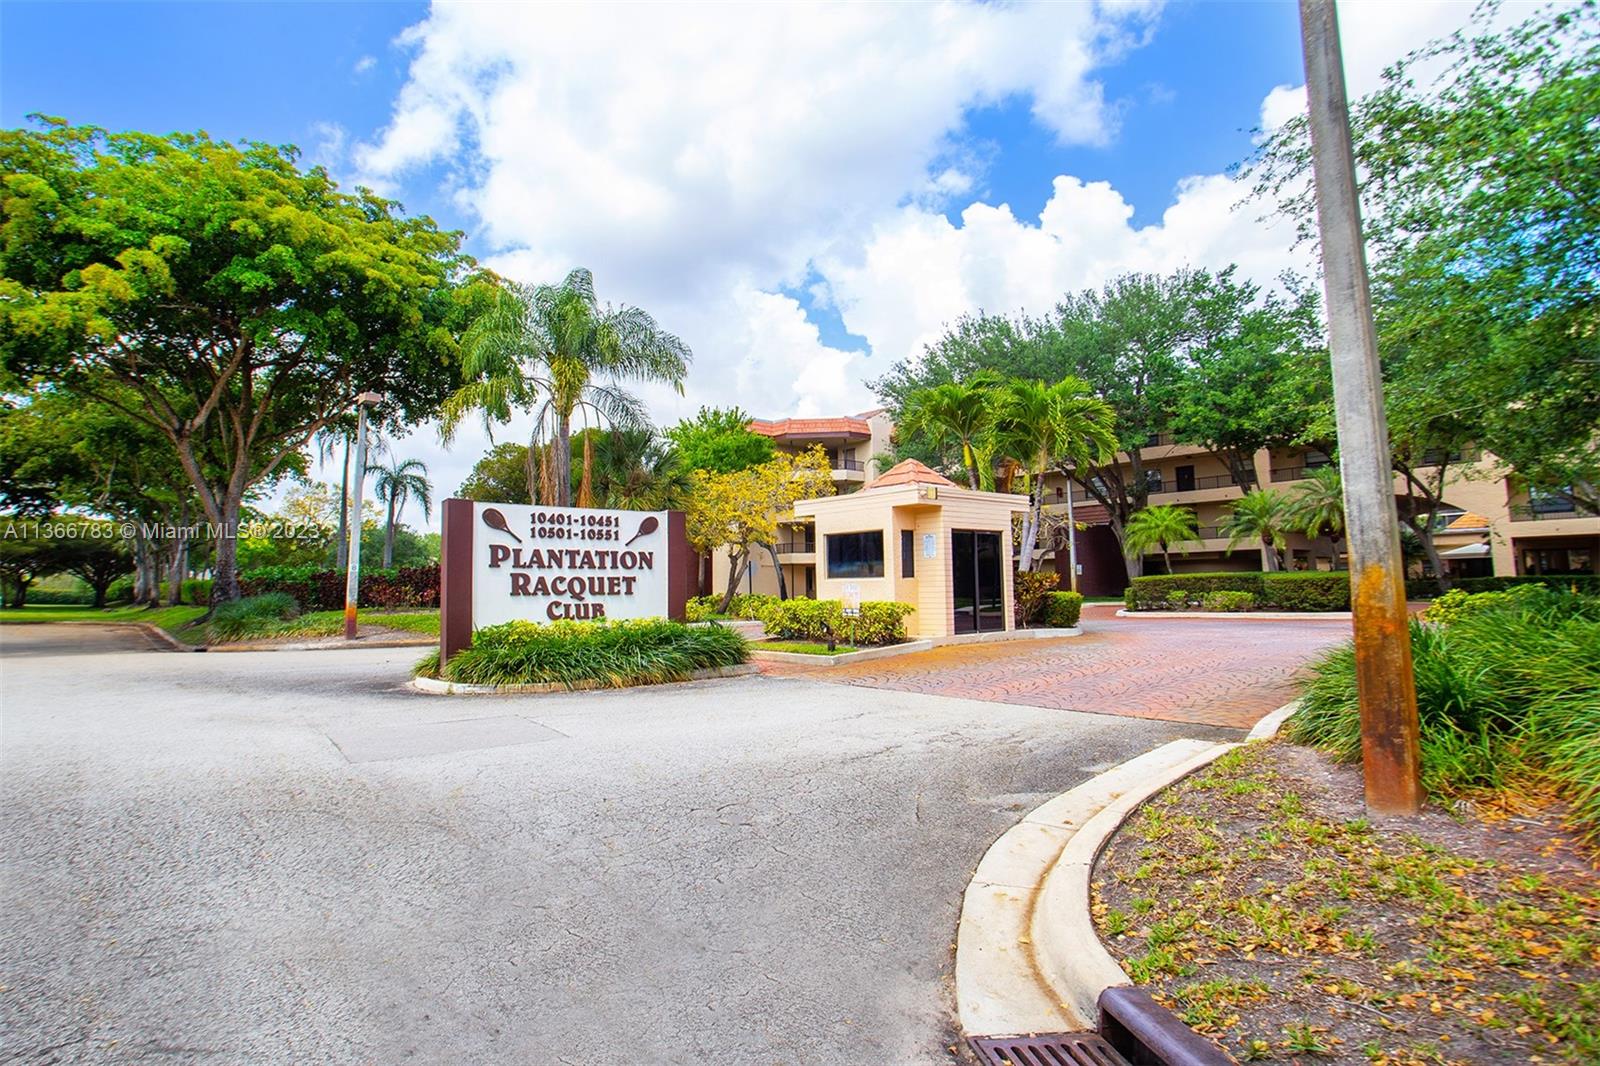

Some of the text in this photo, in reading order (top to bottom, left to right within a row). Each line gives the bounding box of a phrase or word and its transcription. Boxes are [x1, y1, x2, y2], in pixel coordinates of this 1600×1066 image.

[530, 512, 619, 527] 10401-10451
[530, 527, 619, 541] 10501-10551
[488, 544, 654, 570] PLANTATION
[510, 573, 637, 601] RACQUET
[546, 600, 606, 620] CLUB
